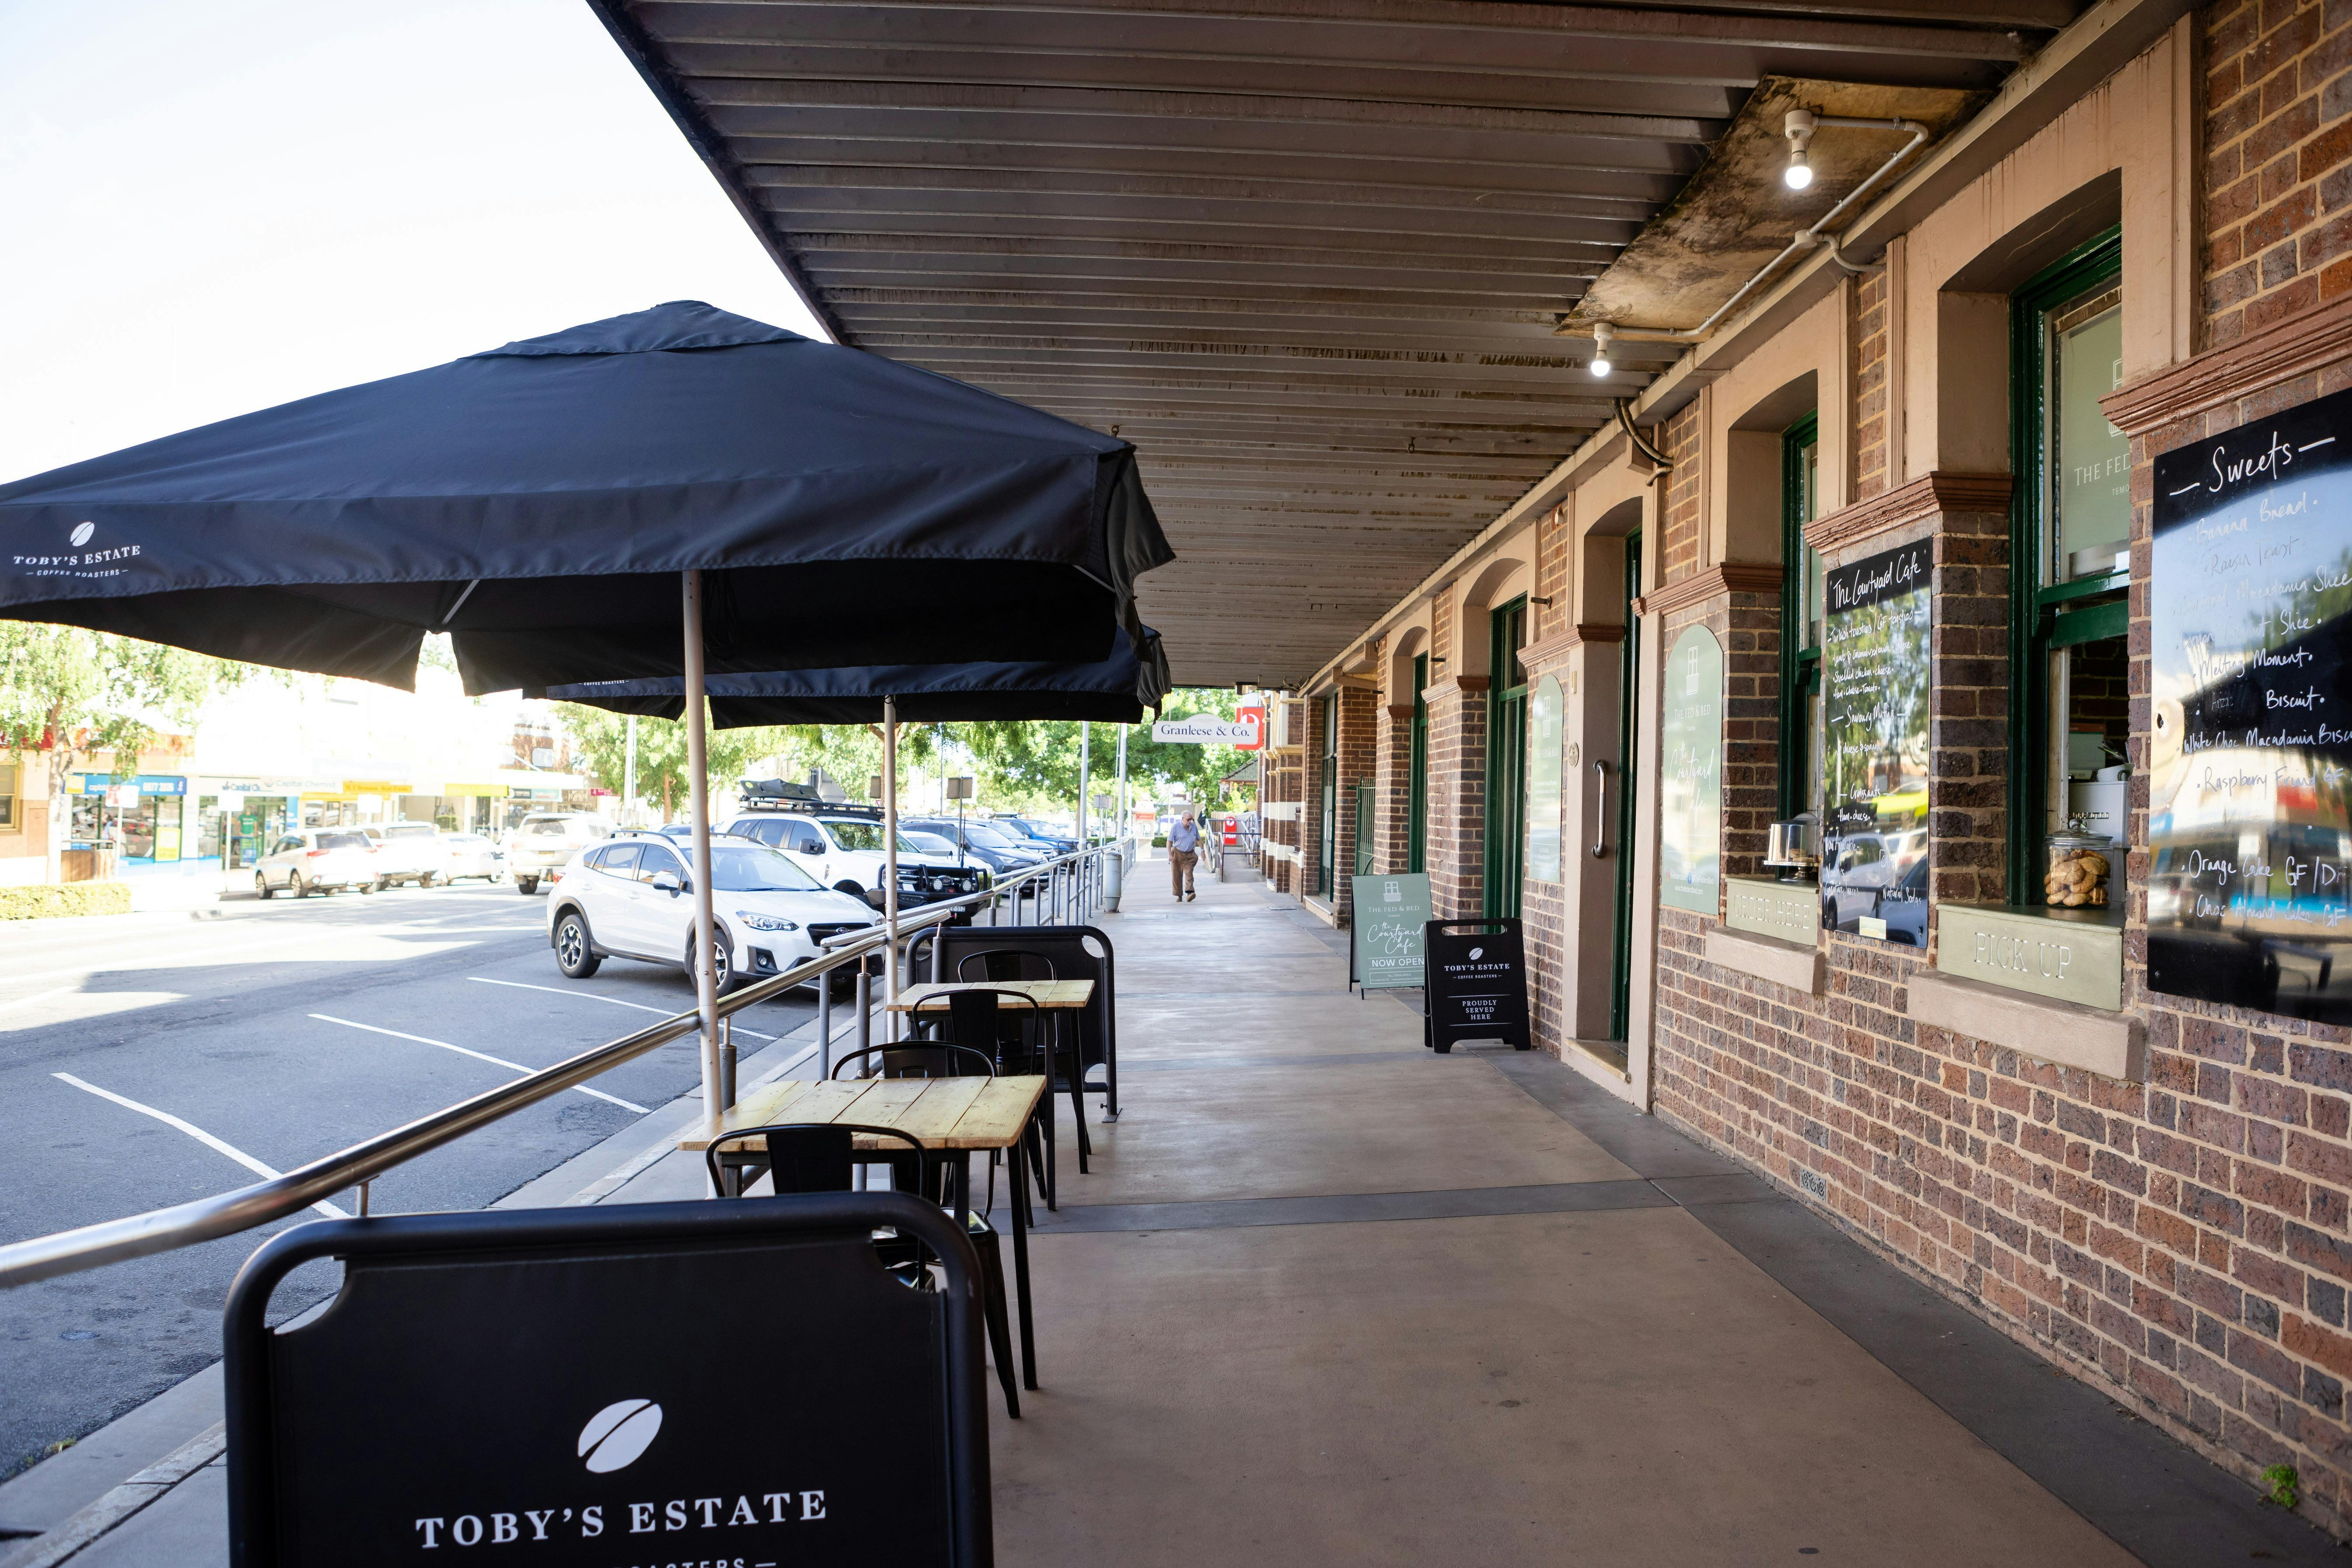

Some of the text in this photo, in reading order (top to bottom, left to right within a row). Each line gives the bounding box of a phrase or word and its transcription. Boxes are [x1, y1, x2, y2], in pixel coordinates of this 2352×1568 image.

[2209, 431, 2292, 493] Sweets
[2074, 467, 2101, 486] THE
[2112, 484, 2130, 496] TEMO
[2196, 492, 2307, 543] Banana Bread
[14, 545, 140, 565] TOBY'S ESTATE
[2210, 535, 2299, 577] Raisin Toast
[75, 569, 119, 578] ROASTERS
[1833, 551, 1921, 612] The Courtyard Cafe
[1830, 625, 1849, 643] Turkish
[1849, 621, 1872, 638] toasties
[1889, 609, 1913, 627] toasties
[2280, 609, 2315, 635] Slice
[2199, 655, 2245, 678] Melting
[1675, 704, 1710, 720] THE FED & BED
[1845, 704, 1872, 732] Savoury
[1161, 724, 1249, 736] Granleese & Co.
[2184, 731, 2212, 754] White
[2215, 730, 2239, 749] Choc
[2246, 727, 2316, 749] Macadamia
[1669, 747, 1714, 796] Courtyard
[2204, 766, 2267, 799] Raspberry
[2323, 766, 2343, 789] GF
[1681, 781, 1705, 829] Cafe
[1839, 808, 1850, 822] Ham
[2189, 849, 2237, 885] Orange
[2242, 854, 2274, 878] Cake
[1883, 884, 1903, 902] Natural
[1734, 895, 1810, 929] ORDER HERE
[2196, 894, 2226, 918] Choc
[2284, 902, 2312, 923] Cake
[2323, 904, 2346, 927] GF
[1367, 924, 1423, 943] Courtyard
[1380, 922, 1391, 931] the
[1385, 936, 1415, 954] Cafe
[1974, 932, 2071, 979] PICK UP
[1372, 957, 1424, 967] NOW OPEN
[415, 1490, 827, 1549] TOBY'S ESTATE
